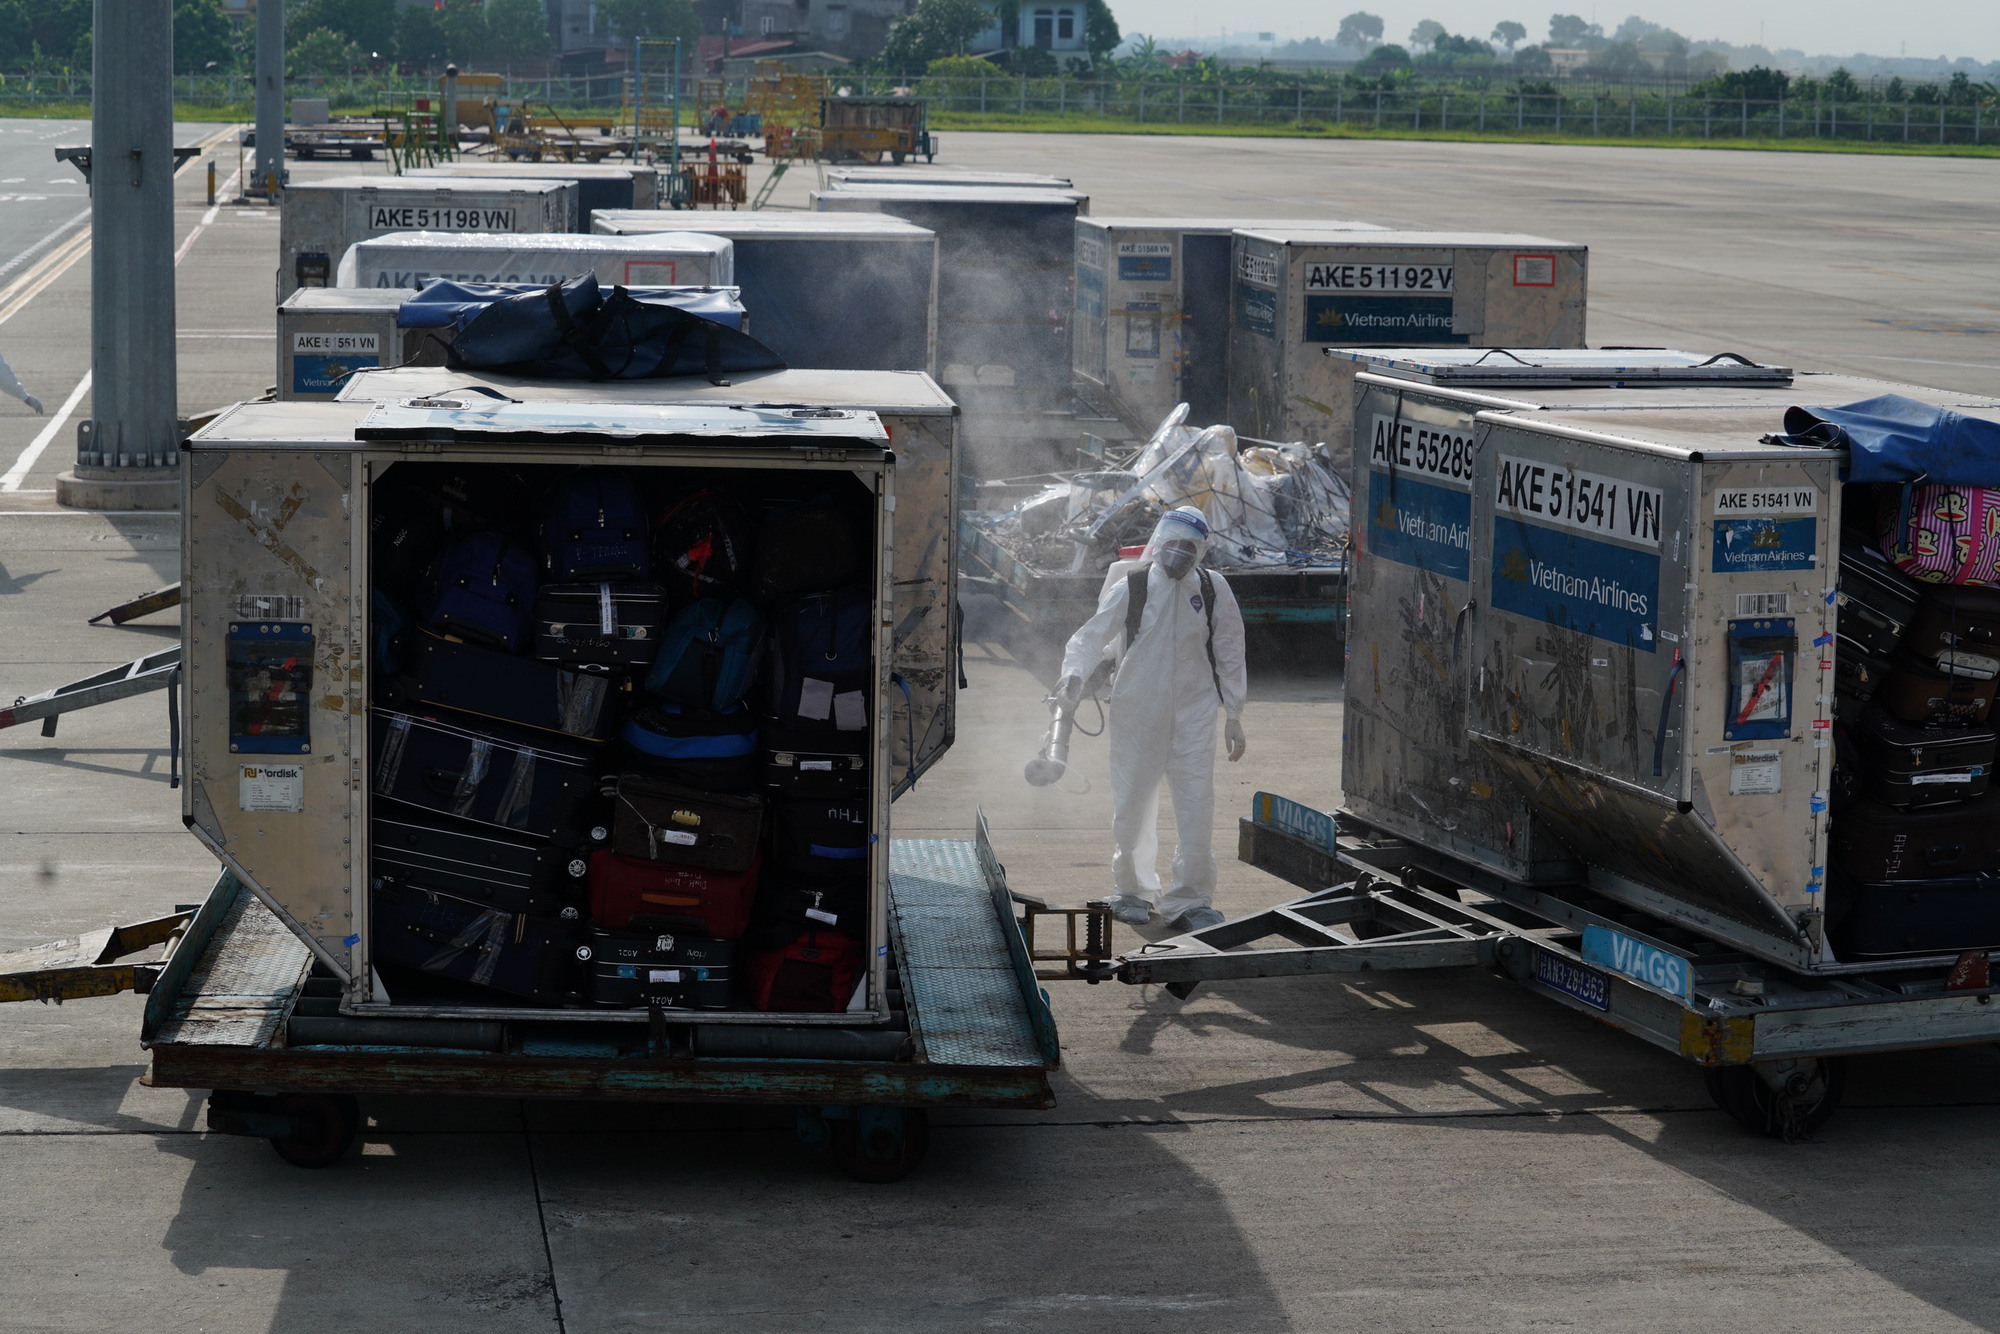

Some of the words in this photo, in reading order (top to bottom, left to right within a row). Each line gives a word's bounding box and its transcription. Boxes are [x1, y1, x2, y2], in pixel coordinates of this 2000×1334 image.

[375, 208, 413, 228] AKE
[418, 209, 480, 229] 51198
[483, 210, 509, 229] VN
[1309, 265, 1355, 288] AKE
[1359, 266, 1433, 289] 51192
[298, 336, 321, 348] AKE
[359, 337, 375, 349] VN
[1372, 420, 1413, 467] AKE
[1416, 429, 1473, 481] 55289
[1498, 460, 1545, 513] AKE
[1549, 472, 1617, 530] 51541
[1627, 487, 1661, 541] VN
[1718, 493, 1748, 509] AKE
[1752, 492, 1790, 508] 51541
[1794, 491, 1812, 507] VN
[1276, 797, 1327, 846] VIAGS
[1612, 931, 1680, 995] VIAGS
[650, 995, 674, 1006] A021
